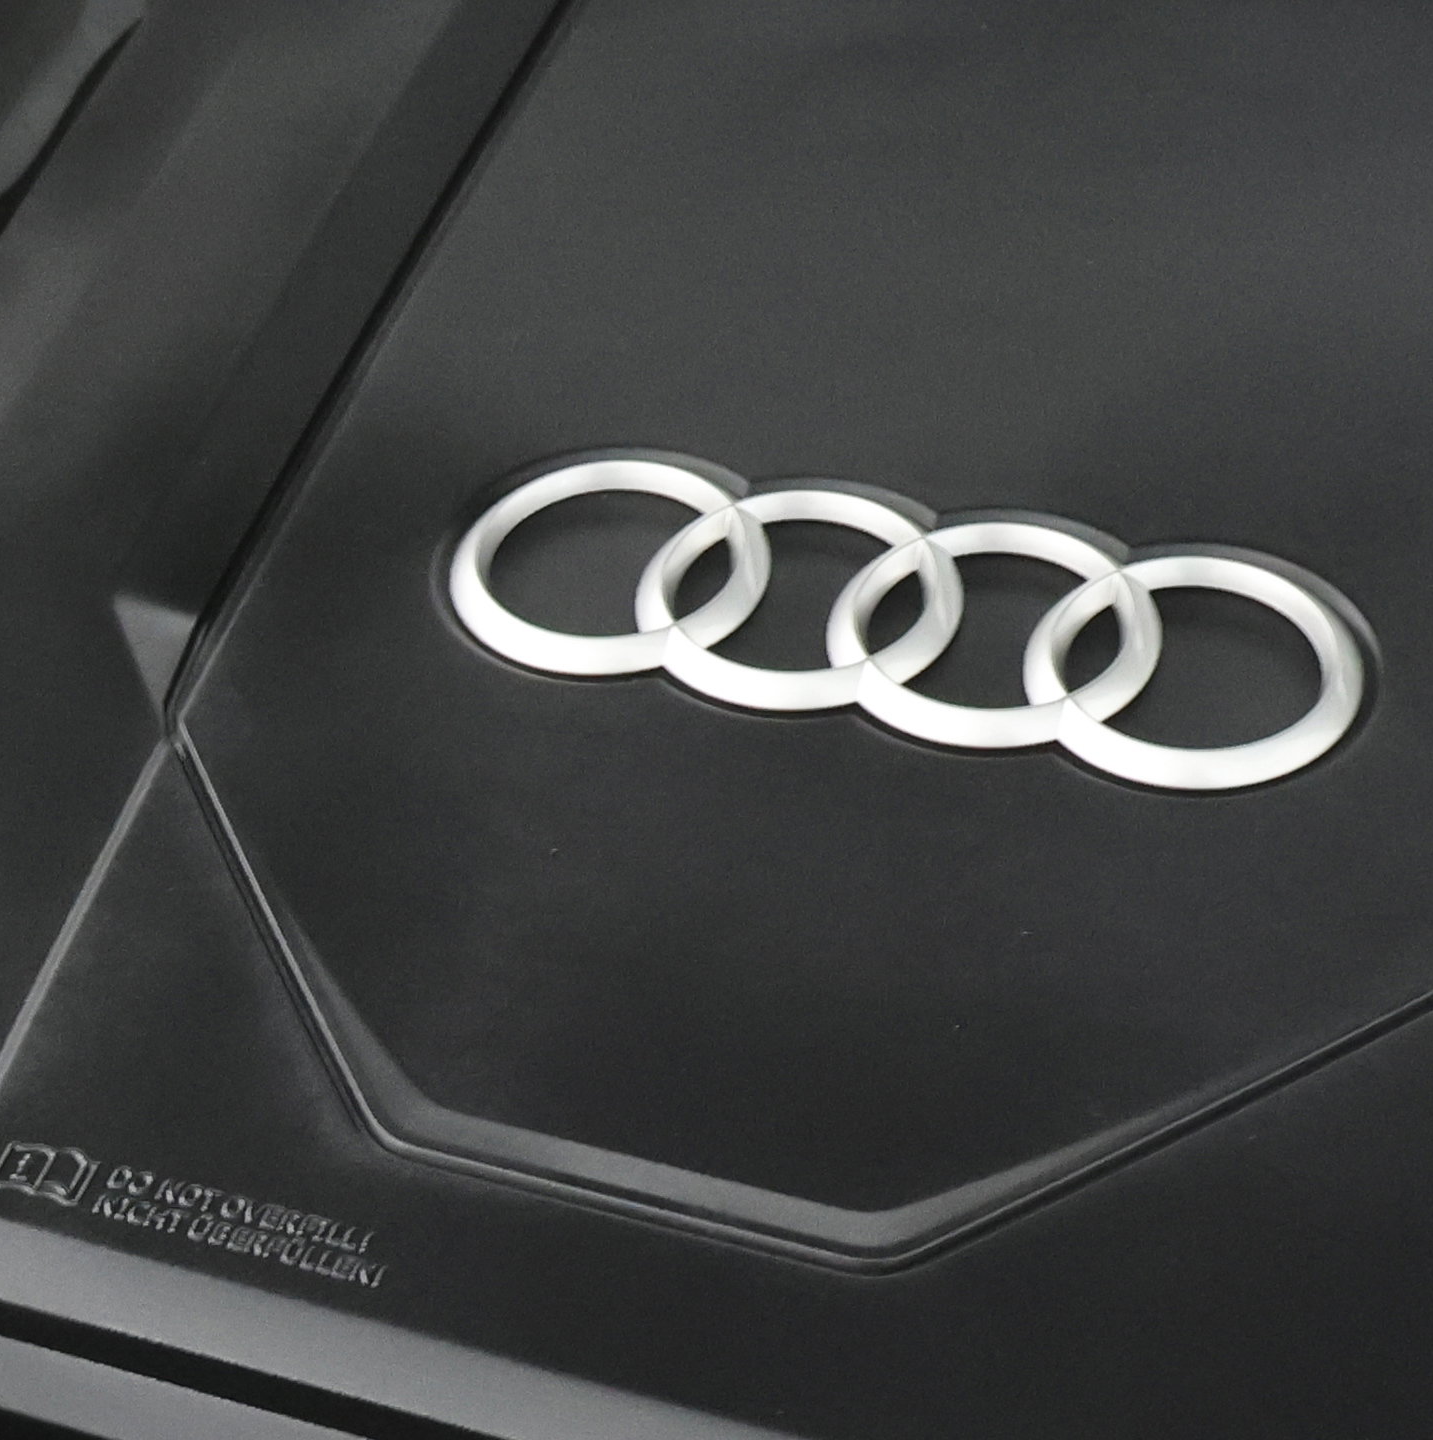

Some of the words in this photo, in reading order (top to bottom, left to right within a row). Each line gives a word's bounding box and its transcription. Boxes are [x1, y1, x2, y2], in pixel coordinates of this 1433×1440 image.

[106, 1165, 155, 1195] DO
[154, 1178, 226, 1212] NOT
[91, 1192, 187, 1233] NICHT
